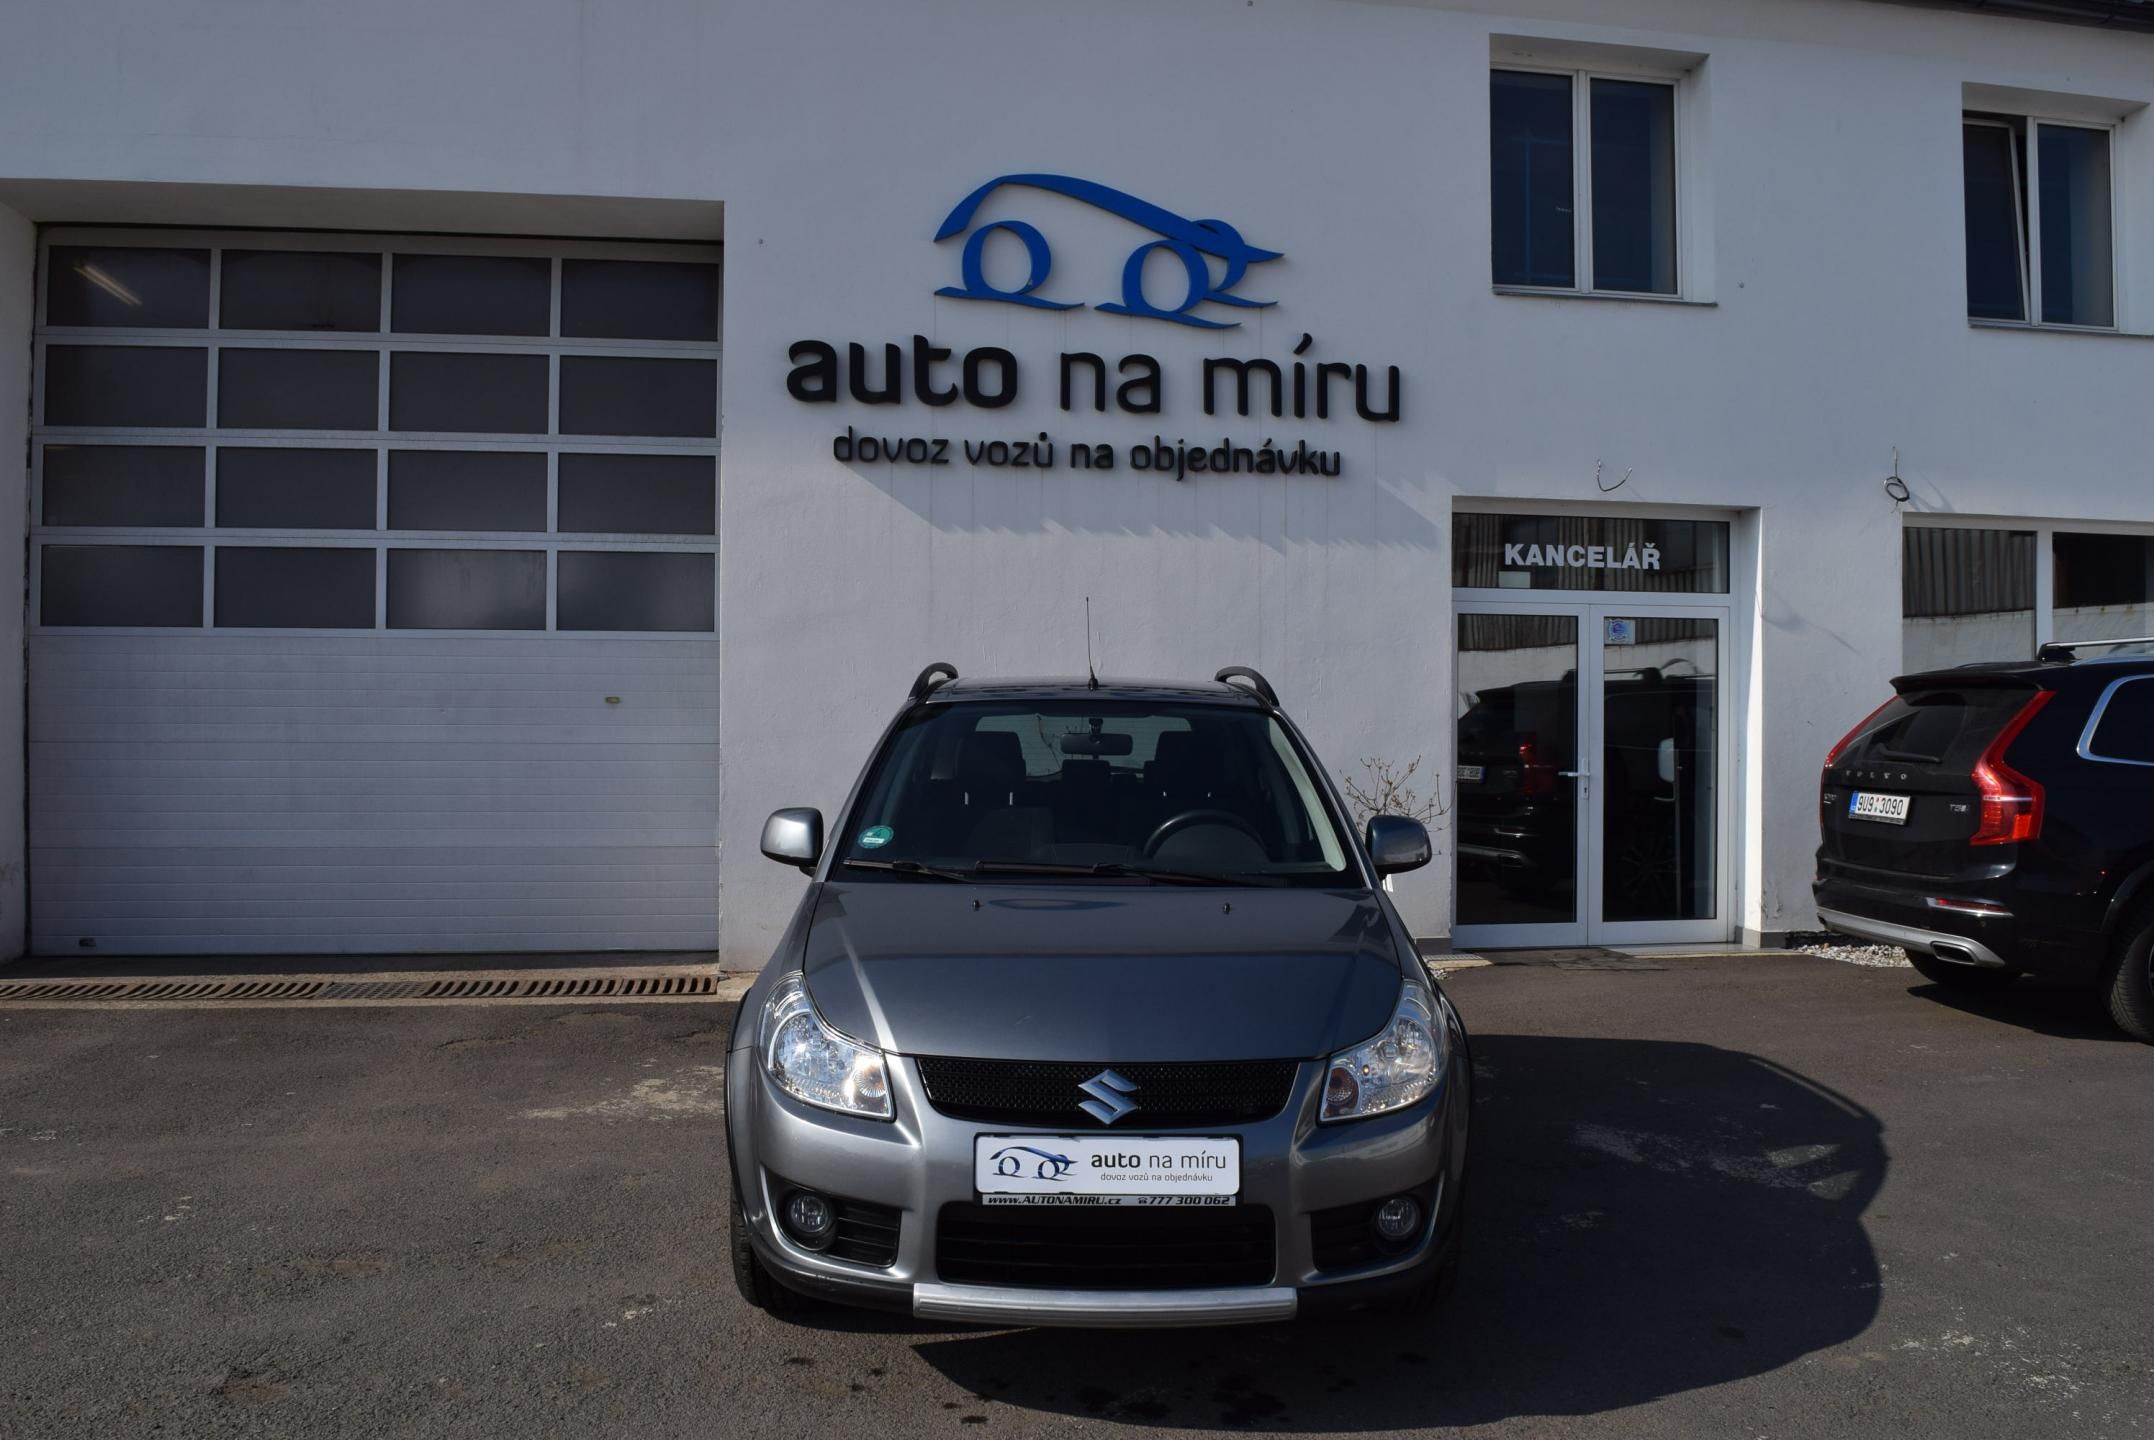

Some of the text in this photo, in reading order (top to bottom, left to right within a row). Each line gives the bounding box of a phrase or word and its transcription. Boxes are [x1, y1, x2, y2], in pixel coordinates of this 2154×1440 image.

[786, 332, 1400, 422] auto na míru
[833, 426, 1342, 482] dovoz vozů na objednávku
[1504, 541, 1661, 570] KANCELÁŘ
[1091, 1150, 1226, 1169] auto na míru
[1100, 1172, 1127, 1181] dovoz
[1128, 1172, 1149, 1181] vozů
[1164, 1173, 1213, 1183] objednávku
[1149, 1196, 1173, 1205] 777
[1175, 1196, 1201, 1205] 300
[1203, 1196, 1230, 1205] 062
